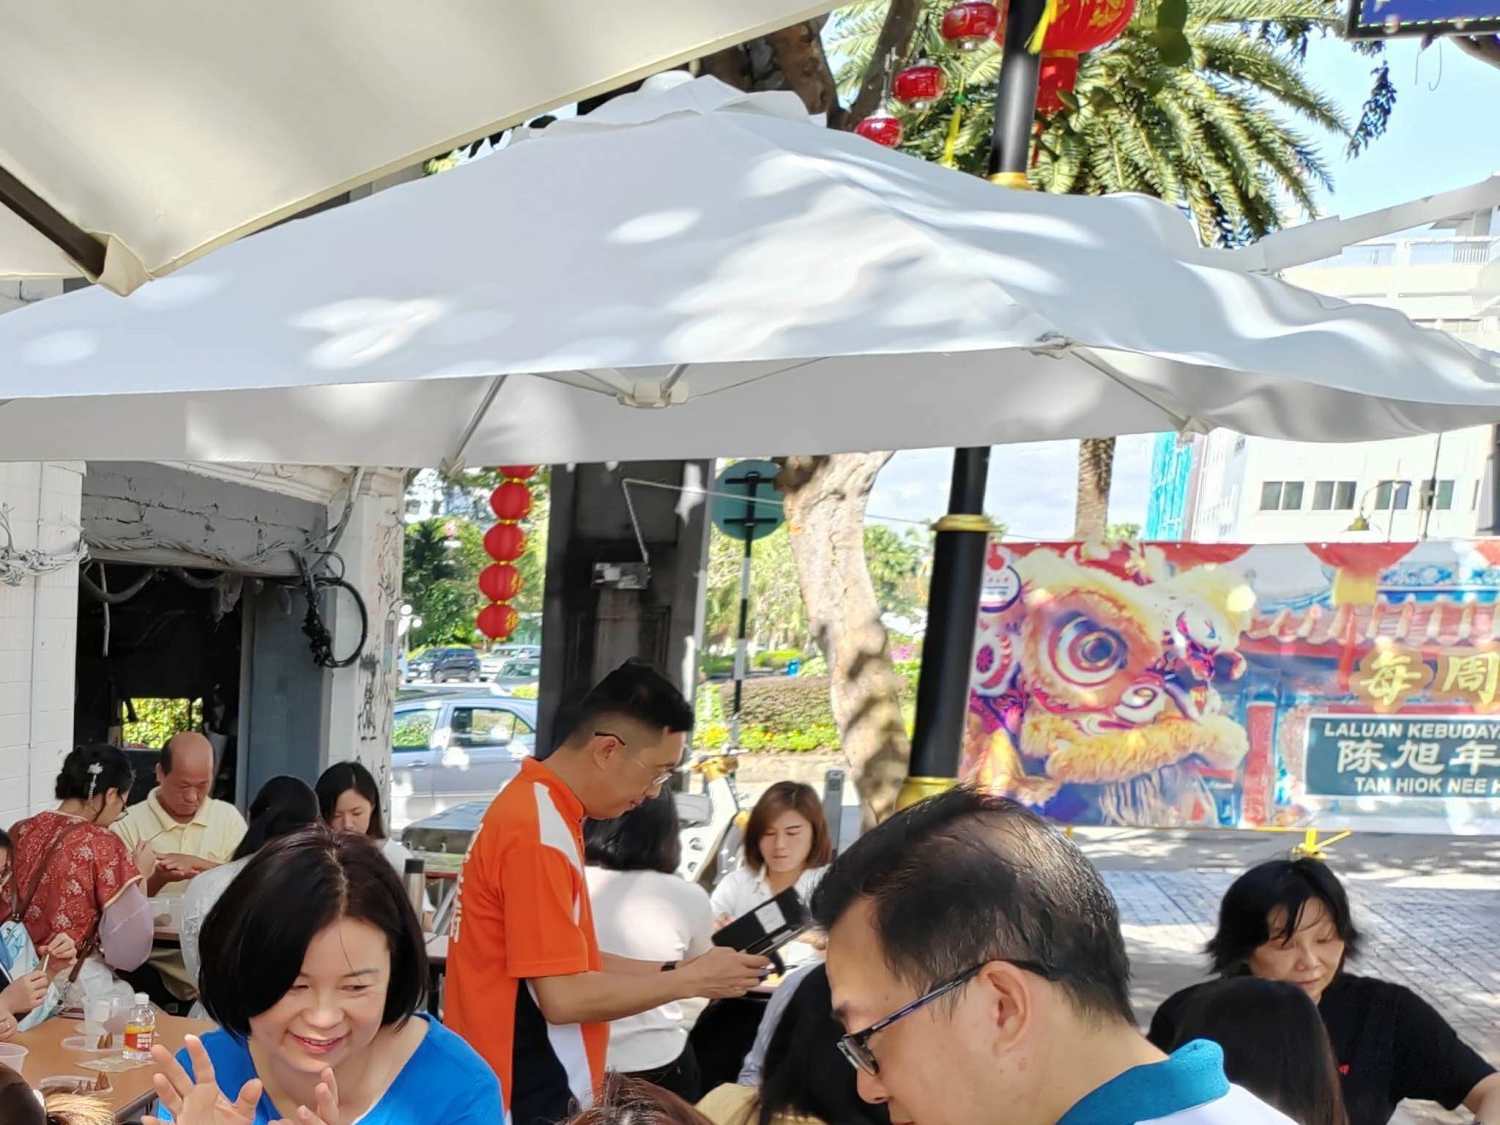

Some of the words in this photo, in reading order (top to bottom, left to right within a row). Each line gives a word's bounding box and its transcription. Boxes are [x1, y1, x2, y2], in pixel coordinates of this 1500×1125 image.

[1359, 649, 1500, 705] 每周
[1324, 722, 1403, 738] LALUAN
[1407, 722, 1500, 740] KEBUDAY
[1336, 739, 1500, 776] 陈旭年
[1354, 776, 1391, 794] TAN
[1395, 776, 1443, 794] HIOK
[1447, 777, 1487, 795] NEE
